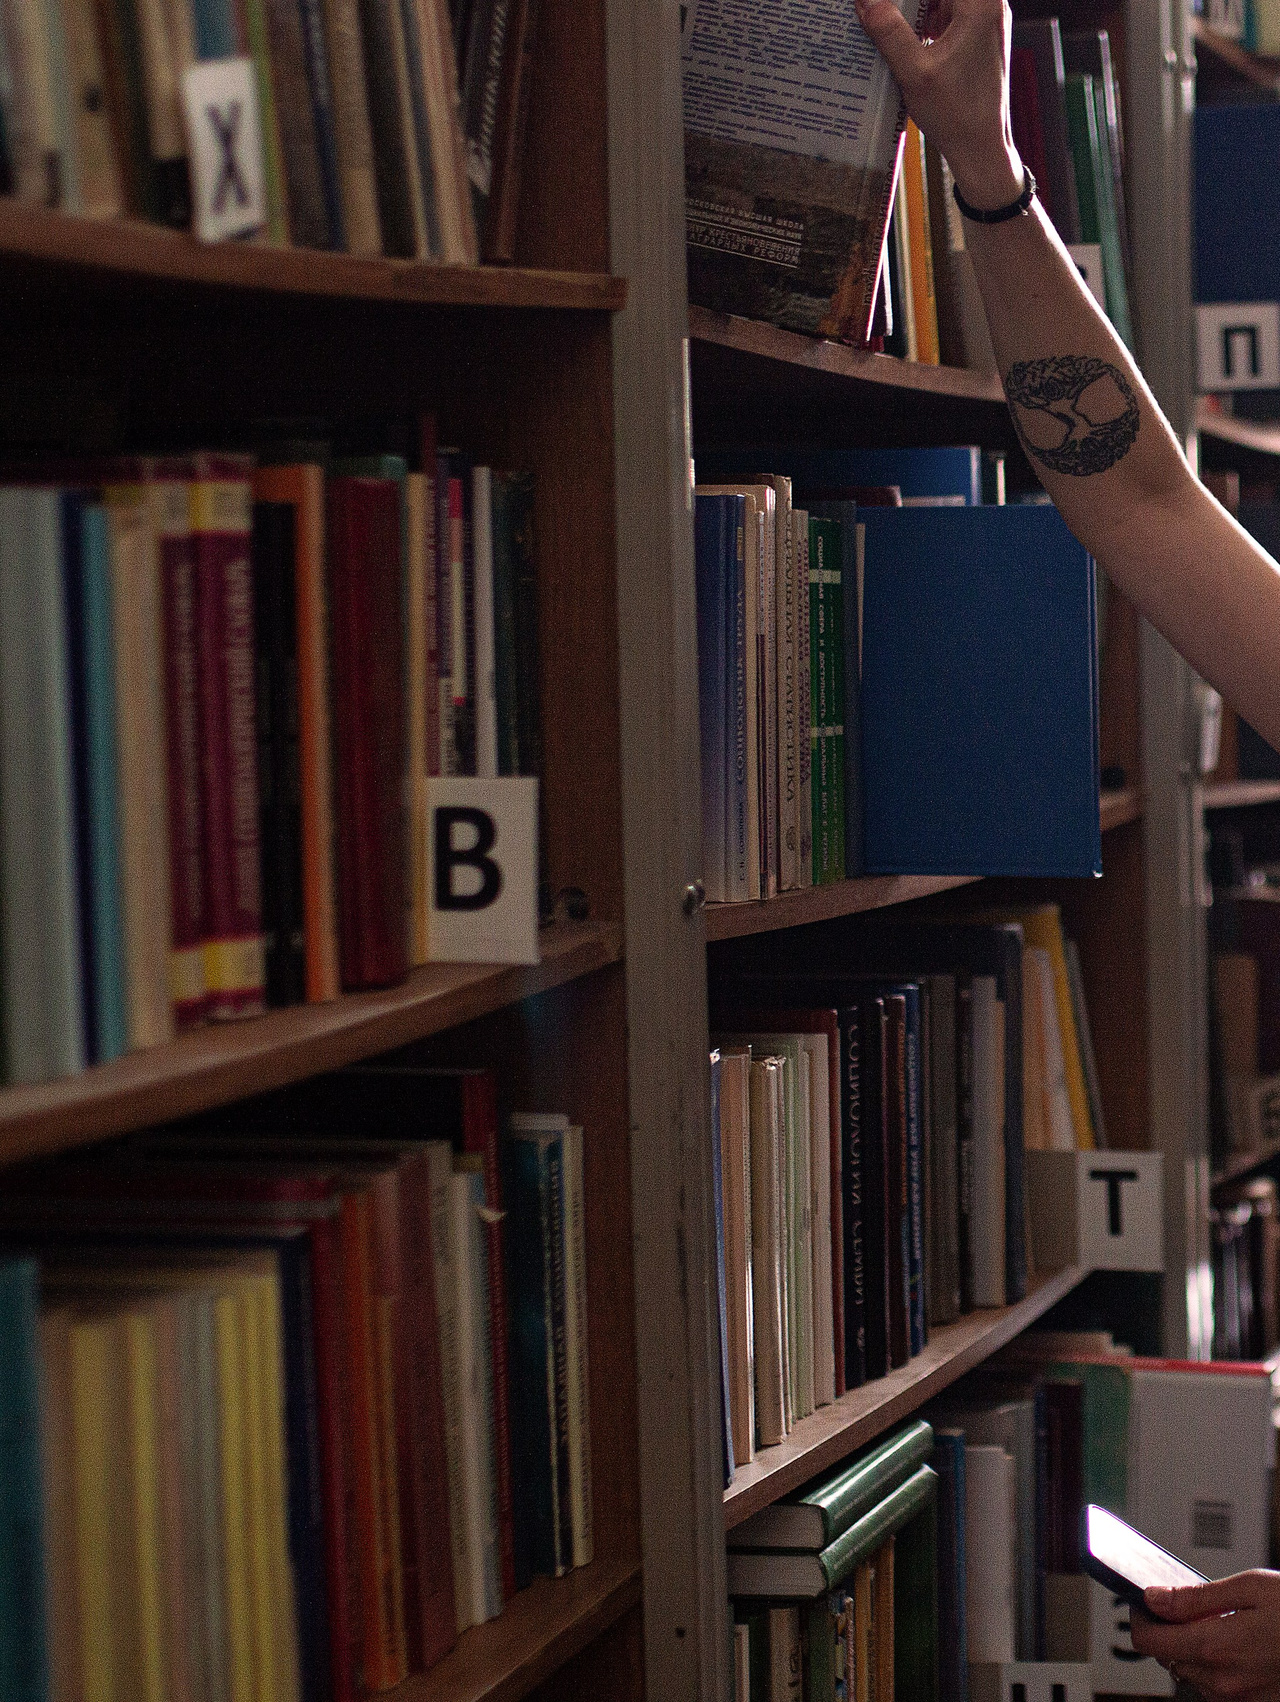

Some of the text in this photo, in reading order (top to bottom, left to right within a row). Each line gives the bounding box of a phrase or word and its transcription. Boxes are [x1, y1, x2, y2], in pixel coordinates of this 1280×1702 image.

[688, 198, 735, 214] ОСКОВСКАЯ
[775, 218, 804, 230] ШКОЛА
[689, 233, 799, 264] АГРАРНЫХ РЕФОРМ
[1223, 325, 1259, 376] П
[817, 535, 826, 600] СОЦИАНАЯ
[818, 603, 826, 634] СФЕРА
[818, 639, 826, 647] И
[818, 651, 827, 719] ДОСТУПНОСТЬ
[819, 722, 828, 786] СЦИАЛЬНЫХ
[821, 792, 829, 815] БЛАГ
[434, 806, 503, 912] В
[1087, 1169, 1138, 1235] Т
